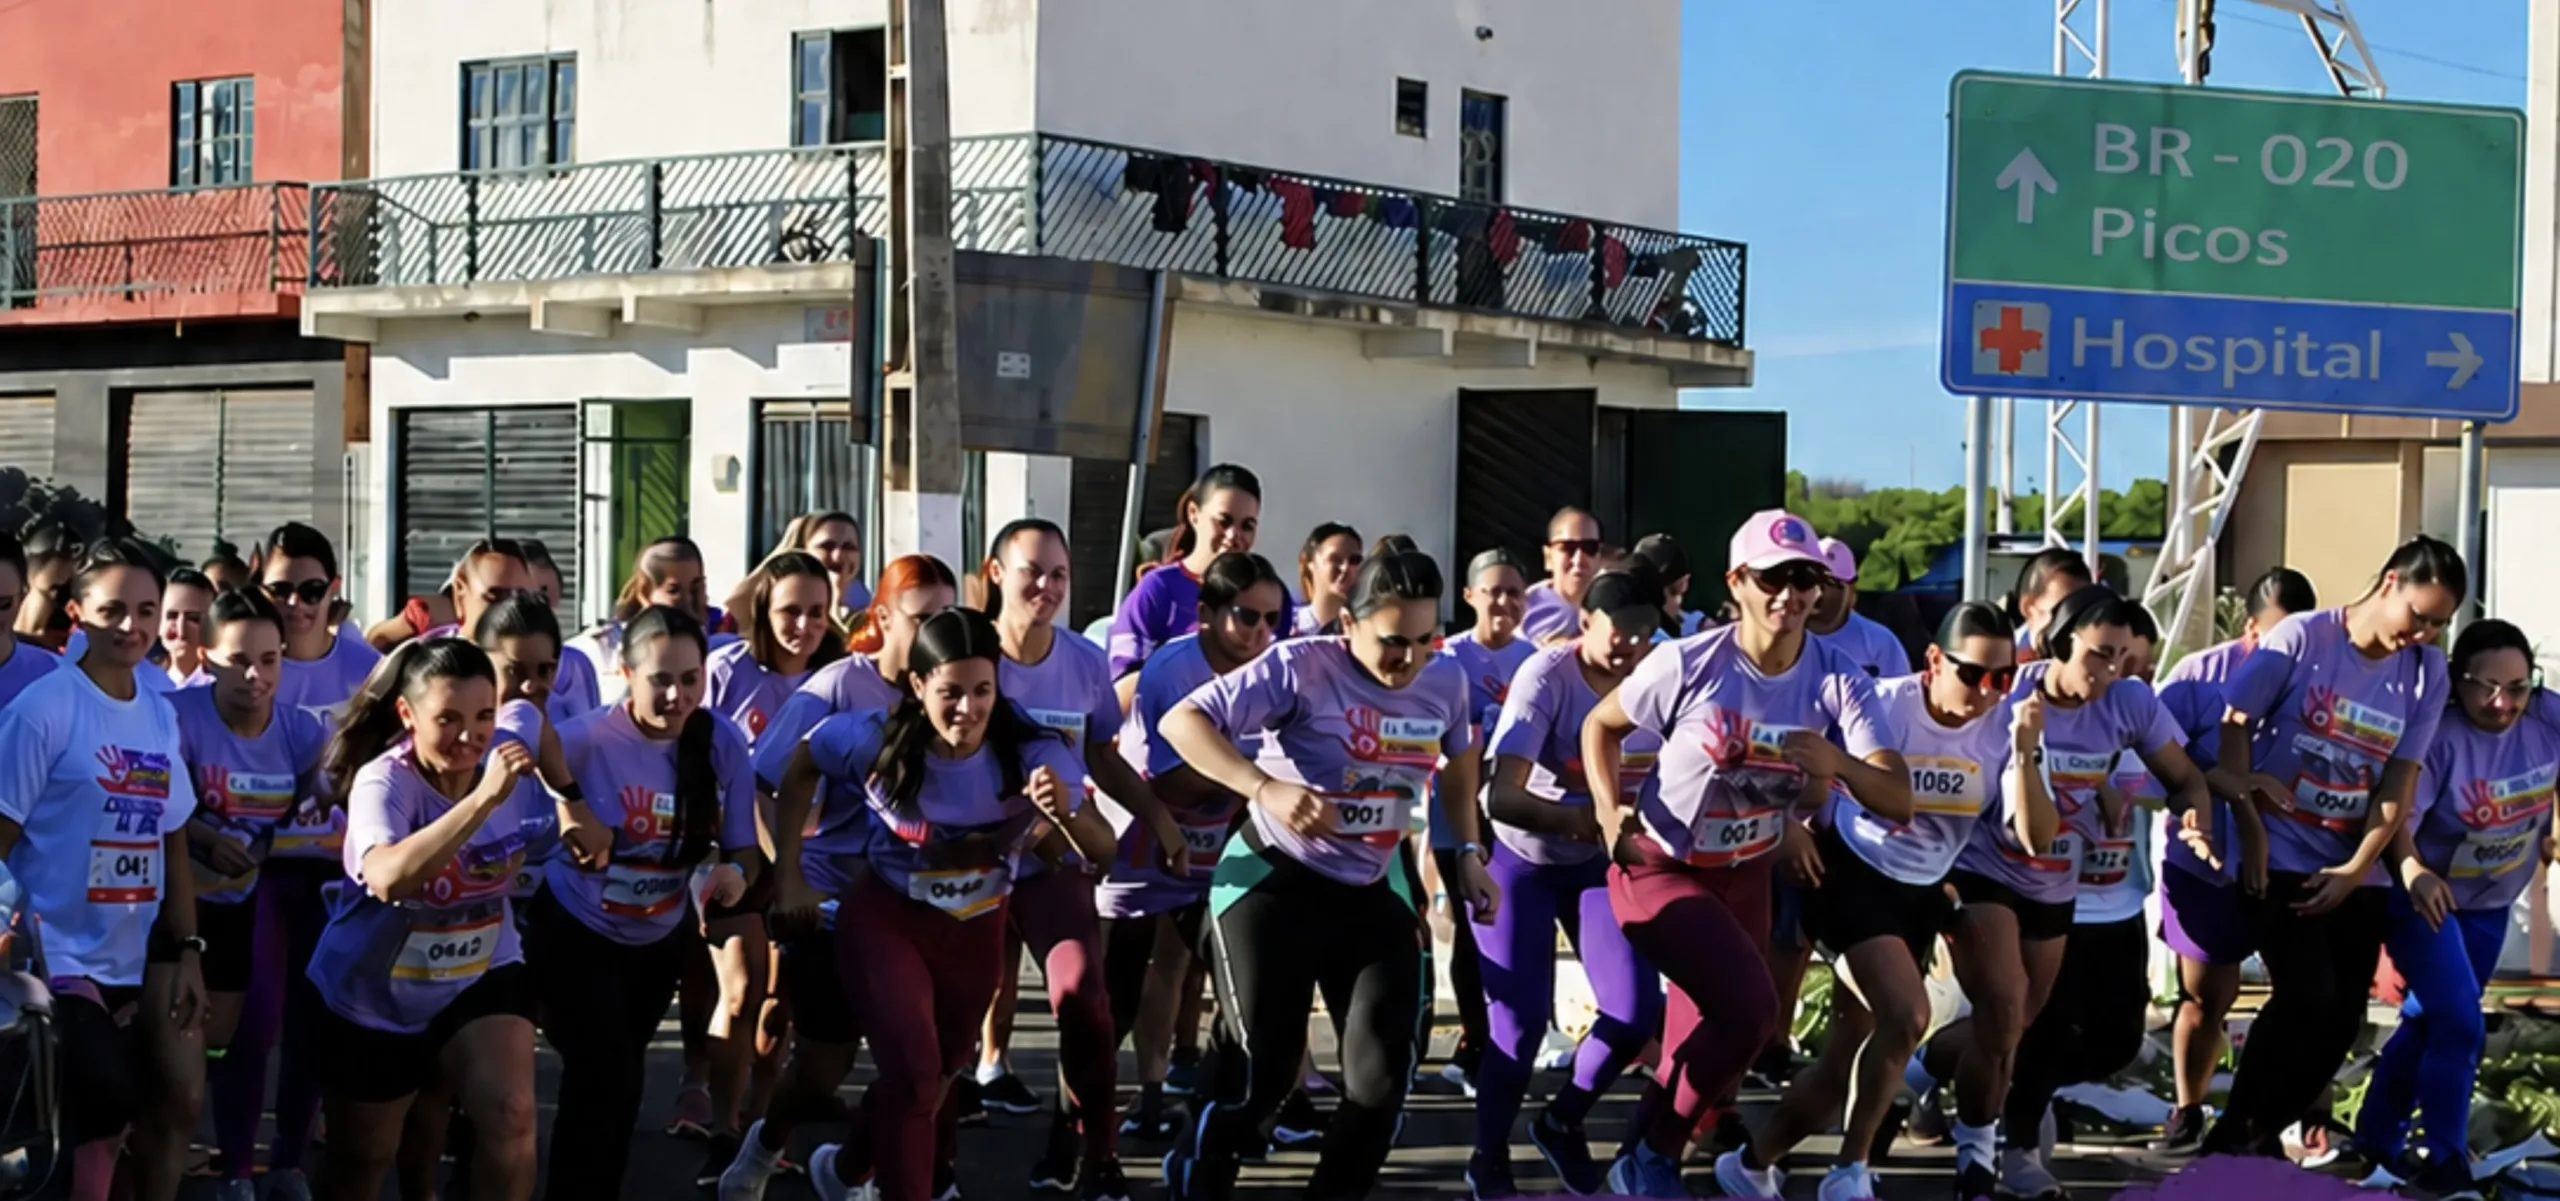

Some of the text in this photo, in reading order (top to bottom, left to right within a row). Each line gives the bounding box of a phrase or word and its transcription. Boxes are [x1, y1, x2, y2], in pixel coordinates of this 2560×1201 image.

[2094, 122, 2409, 191] BR - 020
[2092, 207, 2290, 267] Picos
[2072, 316, 2382, 390] Hospital
[1912, 768, 1965, 795] 1062
